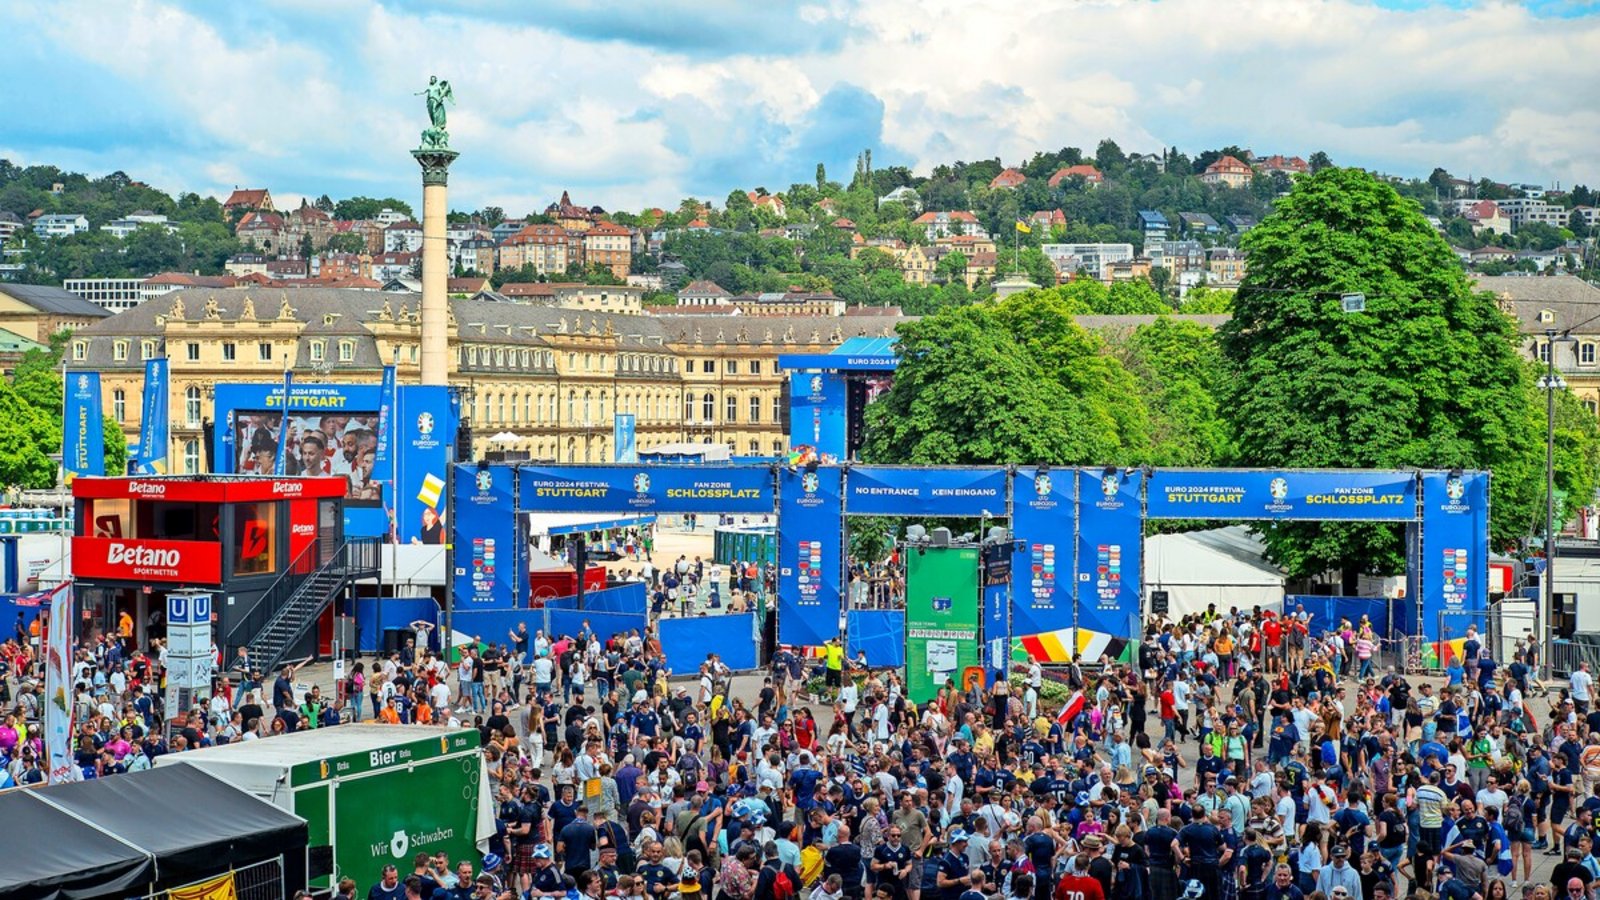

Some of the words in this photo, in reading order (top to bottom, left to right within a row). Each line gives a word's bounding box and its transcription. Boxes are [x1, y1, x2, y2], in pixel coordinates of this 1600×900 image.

[128, 481, 166, 494] Betano
[272, 482, 303, 493] Betano
[536, 488, 607, 497] STUTTGART
[870, 487, 919, 495] ENTRANCE
[666, 489, 760, 498] SCHLOSSPLATZ
[1168, 493, 1243, 503] STUTTGART
[1306, 495, 1404, 504] SCHLOSSPLATZ
[107, 542, 181, 567] Betano
[133, 567, 179, 576] SPORTWETTEN
[171, 599, 186, 617] U
[195, 598, 208, 617] U
[369, 750, 396, 768] Bier
[370, 842, 389, 857] Wir
[411, 826, 454, 847] Schwaben
